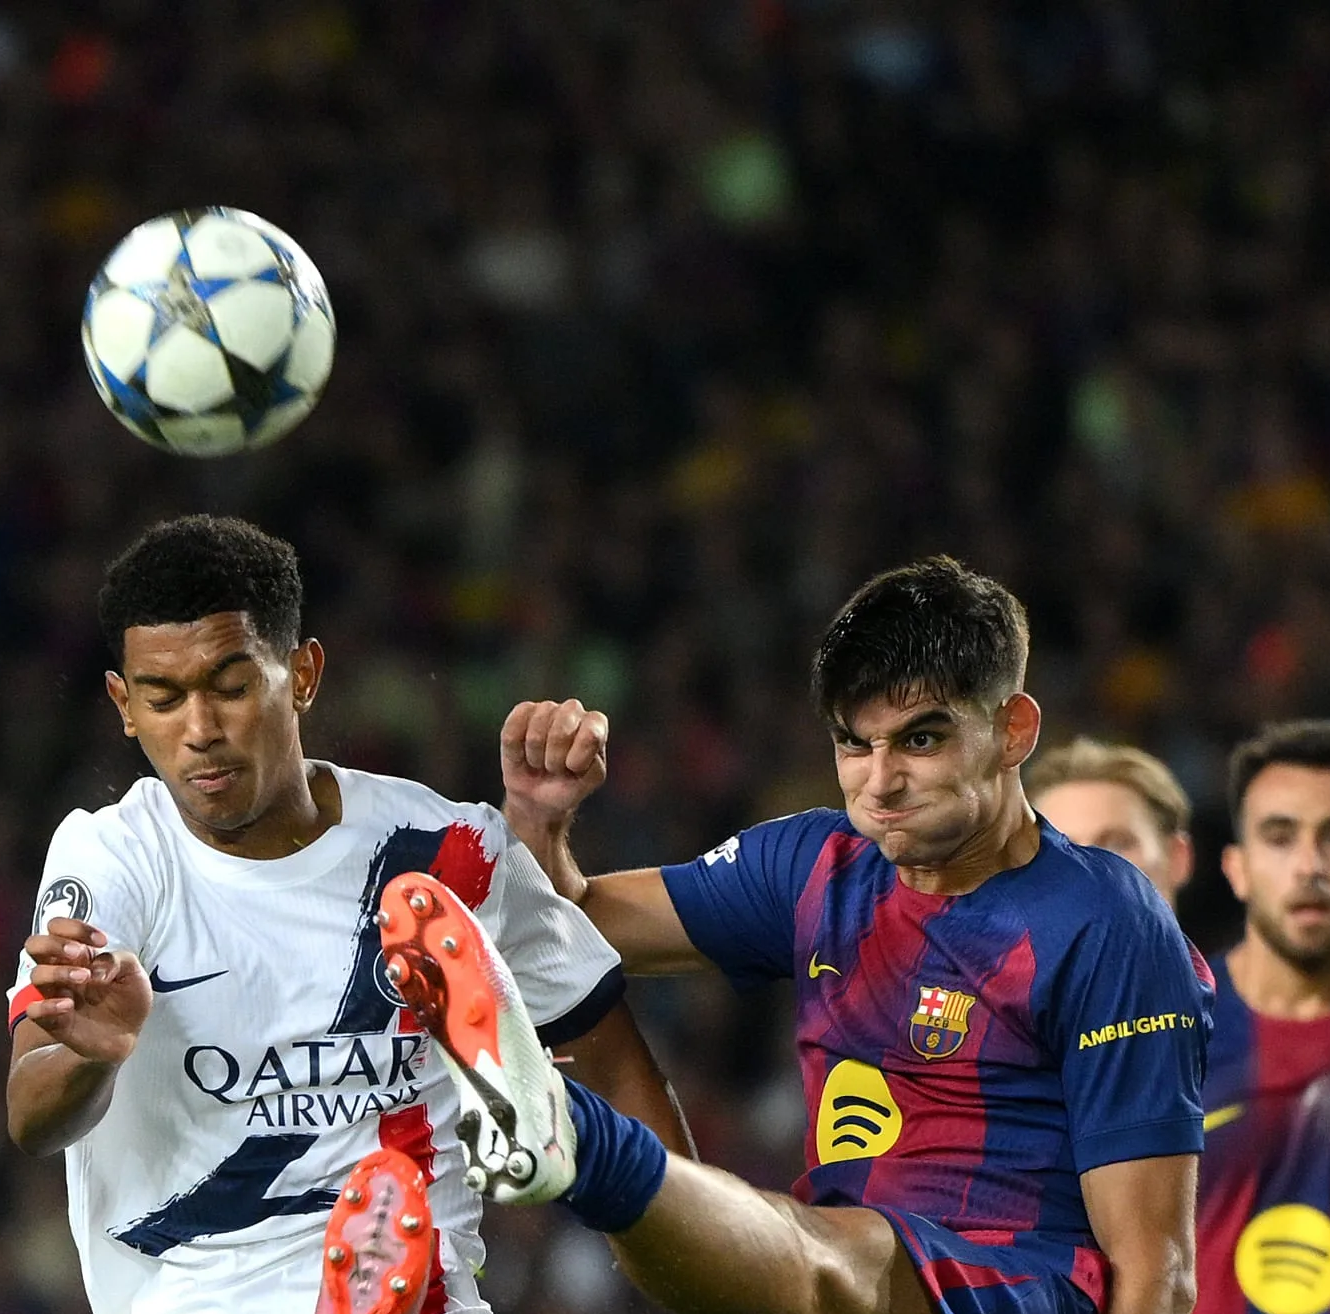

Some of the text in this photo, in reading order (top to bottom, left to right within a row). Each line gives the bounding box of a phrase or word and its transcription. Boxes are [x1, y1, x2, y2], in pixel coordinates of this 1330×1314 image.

[926, 1016, 950, 1029] FCB
[1079, 1014, 1195, 1050] AMBILIGHT tv
[184, 1035, 421, 1105] QATAR
